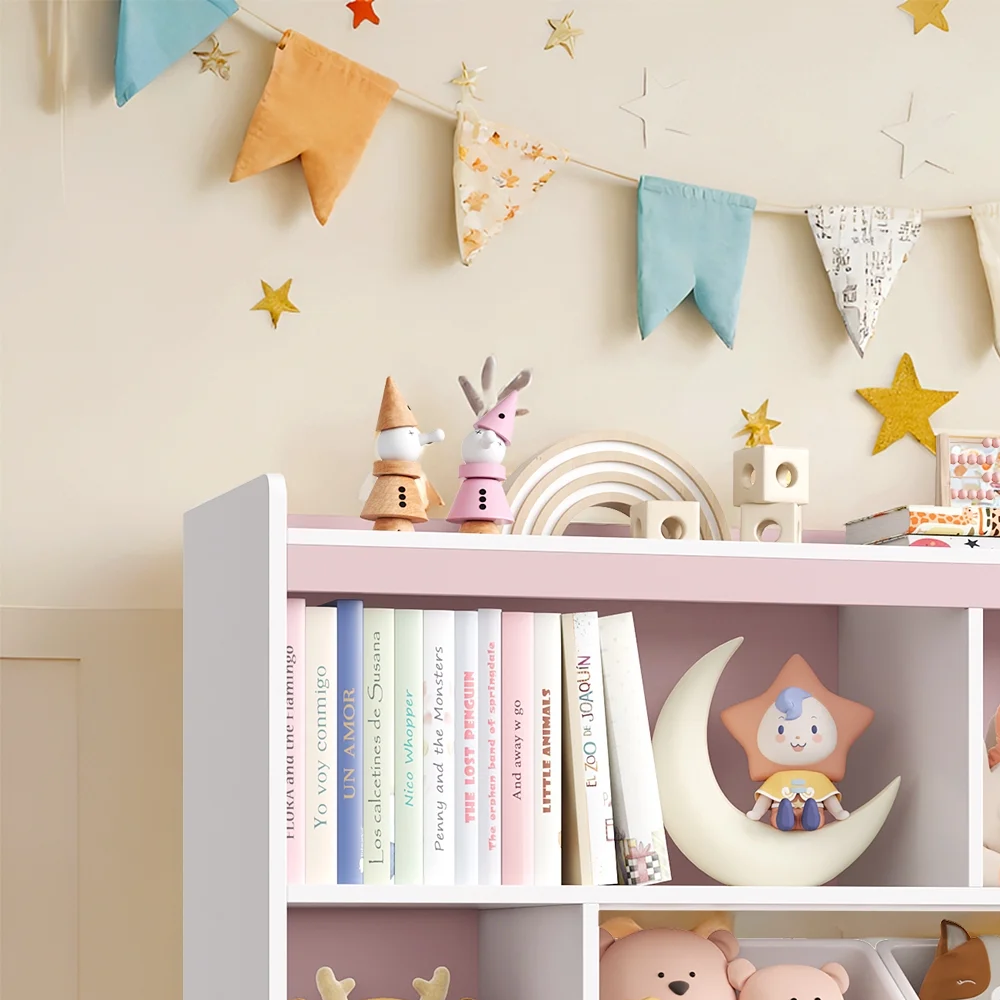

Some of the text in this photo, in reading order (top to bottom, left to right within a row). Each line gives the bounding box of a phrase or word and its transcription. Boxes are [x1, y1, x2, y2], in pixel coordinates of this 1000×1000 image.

[314, 666, 330, 829] Yo voy conmigo
[343, 688, 355, 799] UN AMOR
[367, 632, 383, 863] Los calcetines de Susana
[404, 689, 415, 806] Nico Whopper
[433, 647, 447, 851] Penny and the Monsters
[464, 671, 475, 823] THE LOST PENGUIN
[487, 642, 496, 851] The orphan band of springdale
[576, 656, 594, 723] JOAQUÍN
[583, 725, 593, 737] DE
[512, 700, 523, 800] And away w go
[542, 689, 551, 813] LITTLE ANIMALS
[585, 776, 598, 788] EL
